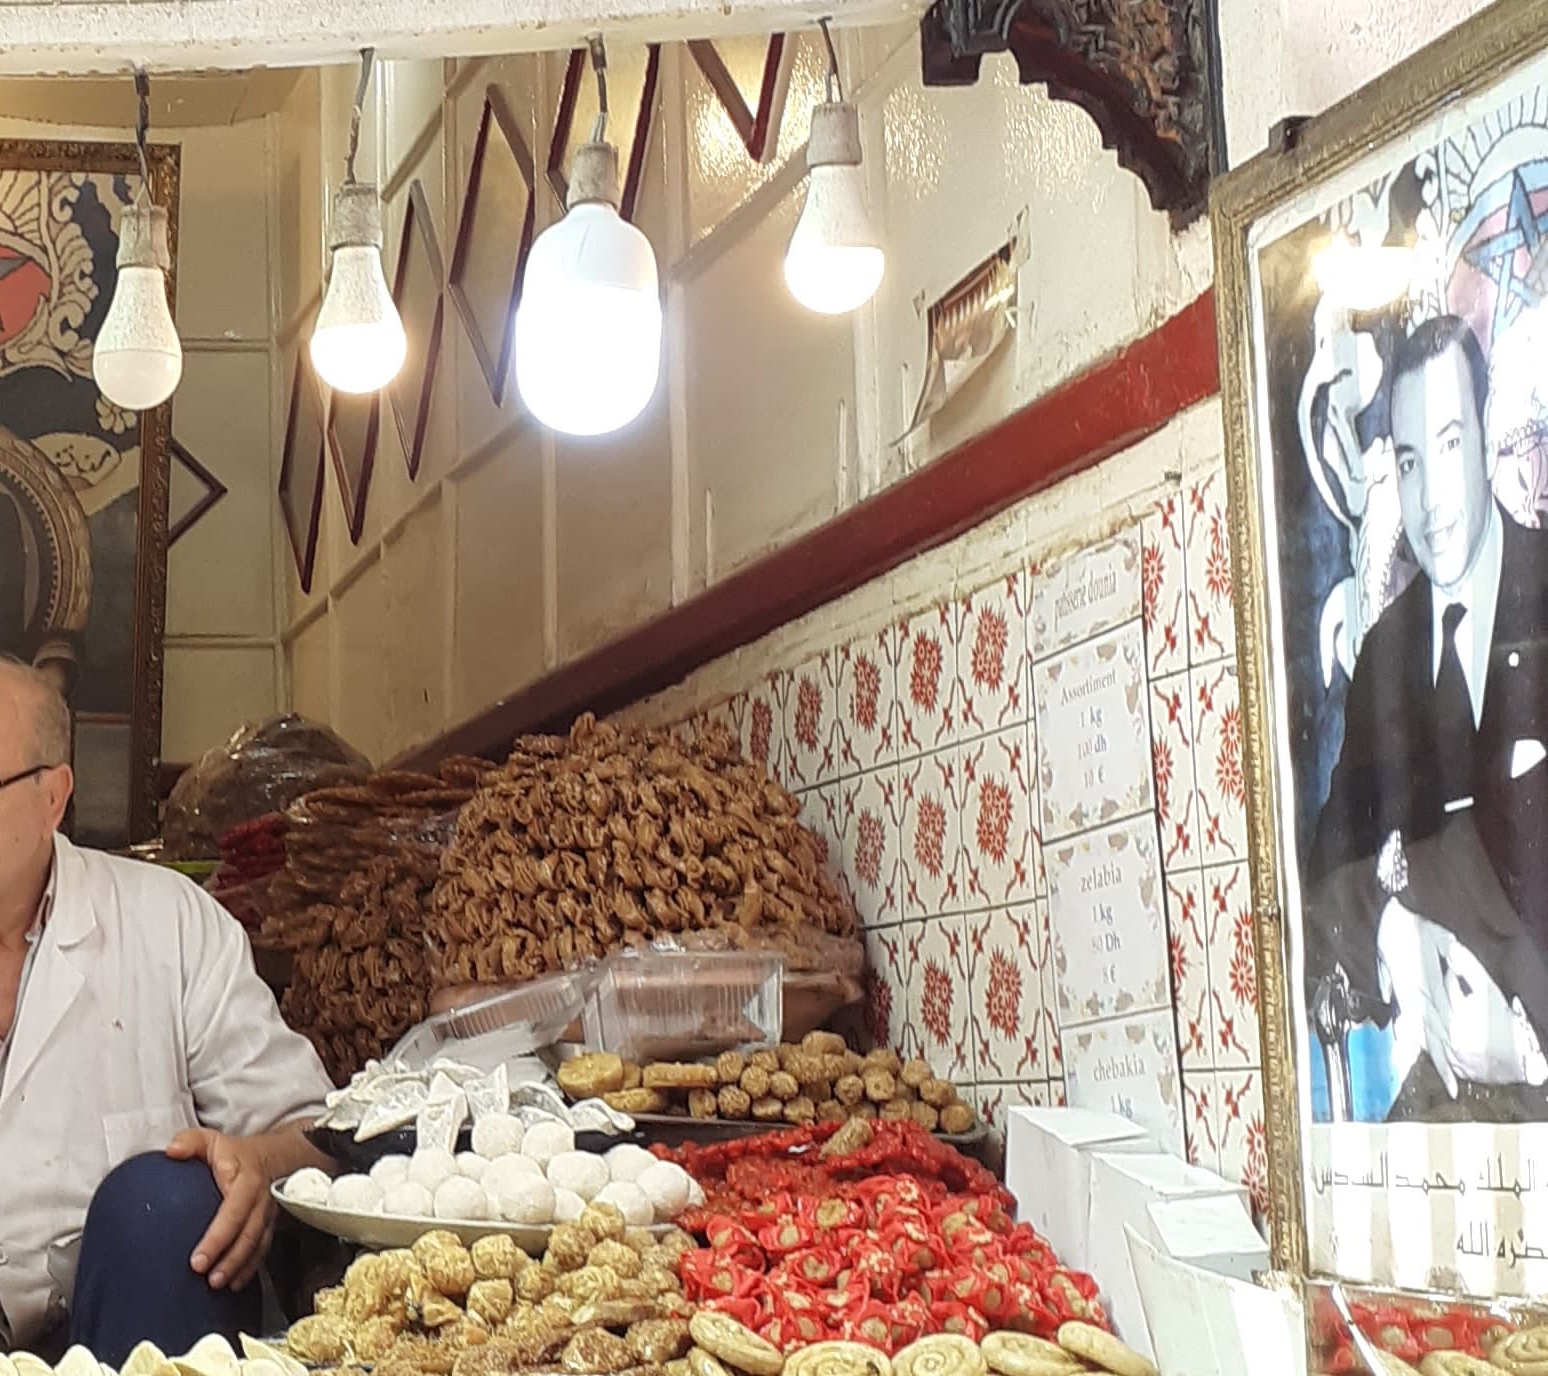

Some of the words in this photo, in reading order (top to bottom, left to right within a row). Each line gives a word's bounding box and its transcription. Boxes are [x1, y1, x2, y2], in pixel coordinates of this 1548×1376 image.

[1060, 668, 1117, 706] Assortiment
[1089, 705, 1103, 729] kg
[1094, 734, 1107, 753] dh
[1097, 764, 1105, 785] €
[1080, 860, 1122, 893] zelabia
[1098, 902, 1113, 926] kg
[1105, 930, 1121, 953] Dh
[1093, 1052, 1147, 1082] chebakia
[1117, 1091, 1133, 1120] kg
[1395, 1171, 1466, 1197] محمد
[1476, 1152, 1536, 1200] الملك
[1456, 1219, 1489, 1256] الله
